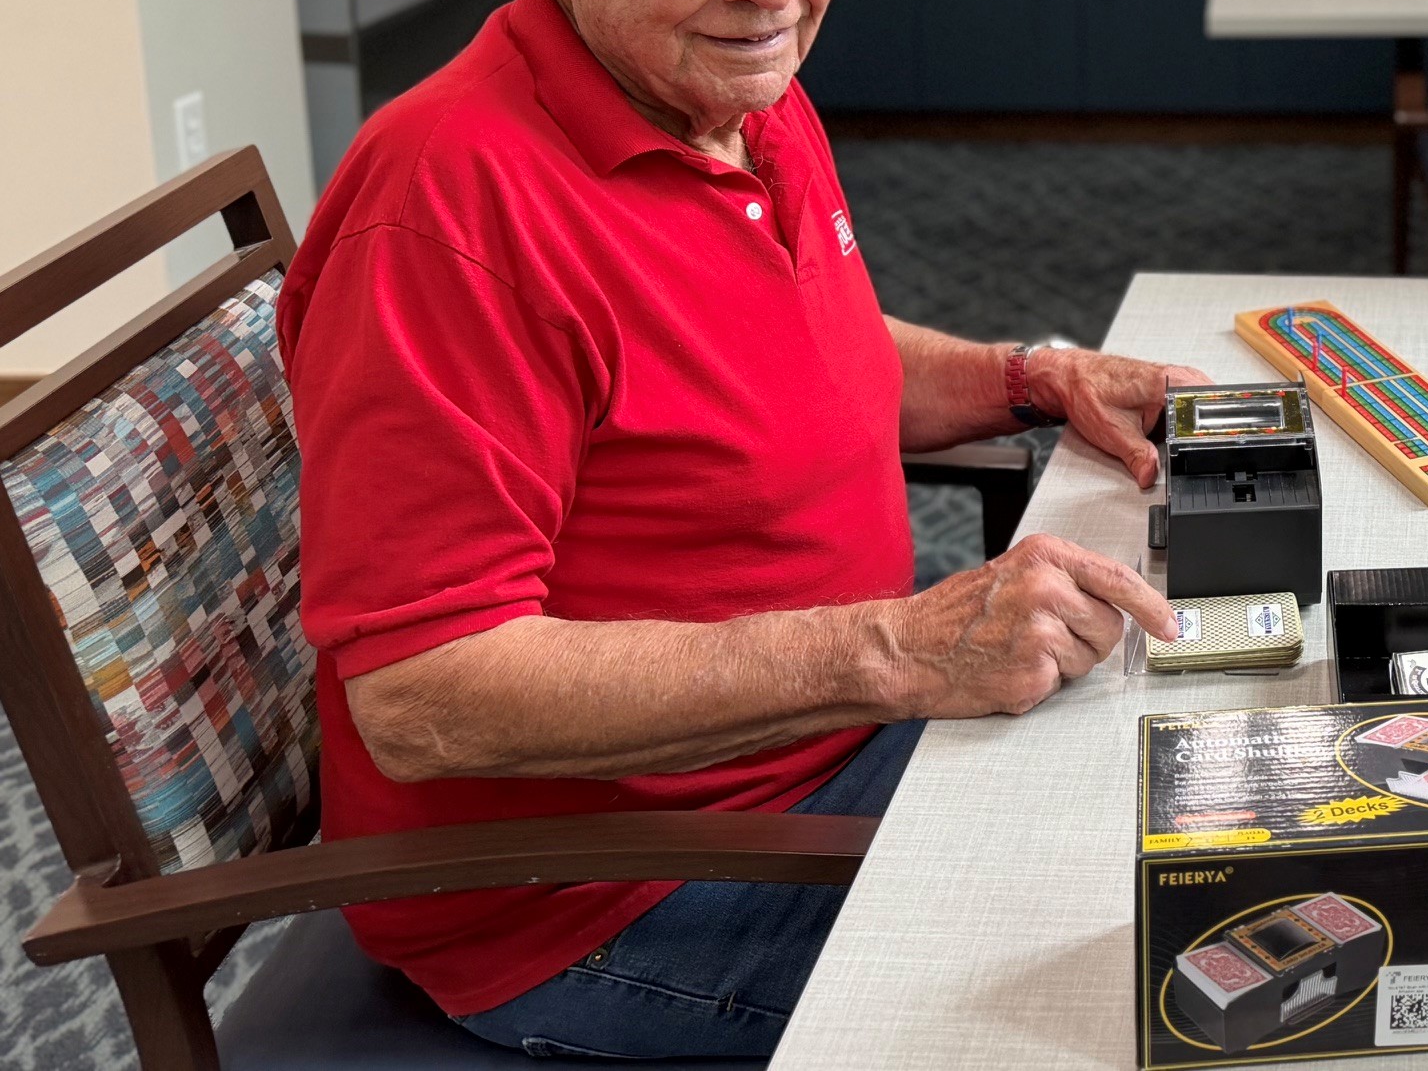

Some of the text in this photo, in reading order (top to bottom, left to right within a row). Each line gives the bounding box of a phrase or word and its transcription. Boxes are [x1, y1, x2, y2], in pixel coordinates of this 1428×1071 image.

[1174, 732, 1291, 751] Automatic
[1175, 748, 1232, 763] Card
[1312, 799, 1391, 821] 2 Decks
[1149, 836, 1182, 845] FAMILY
